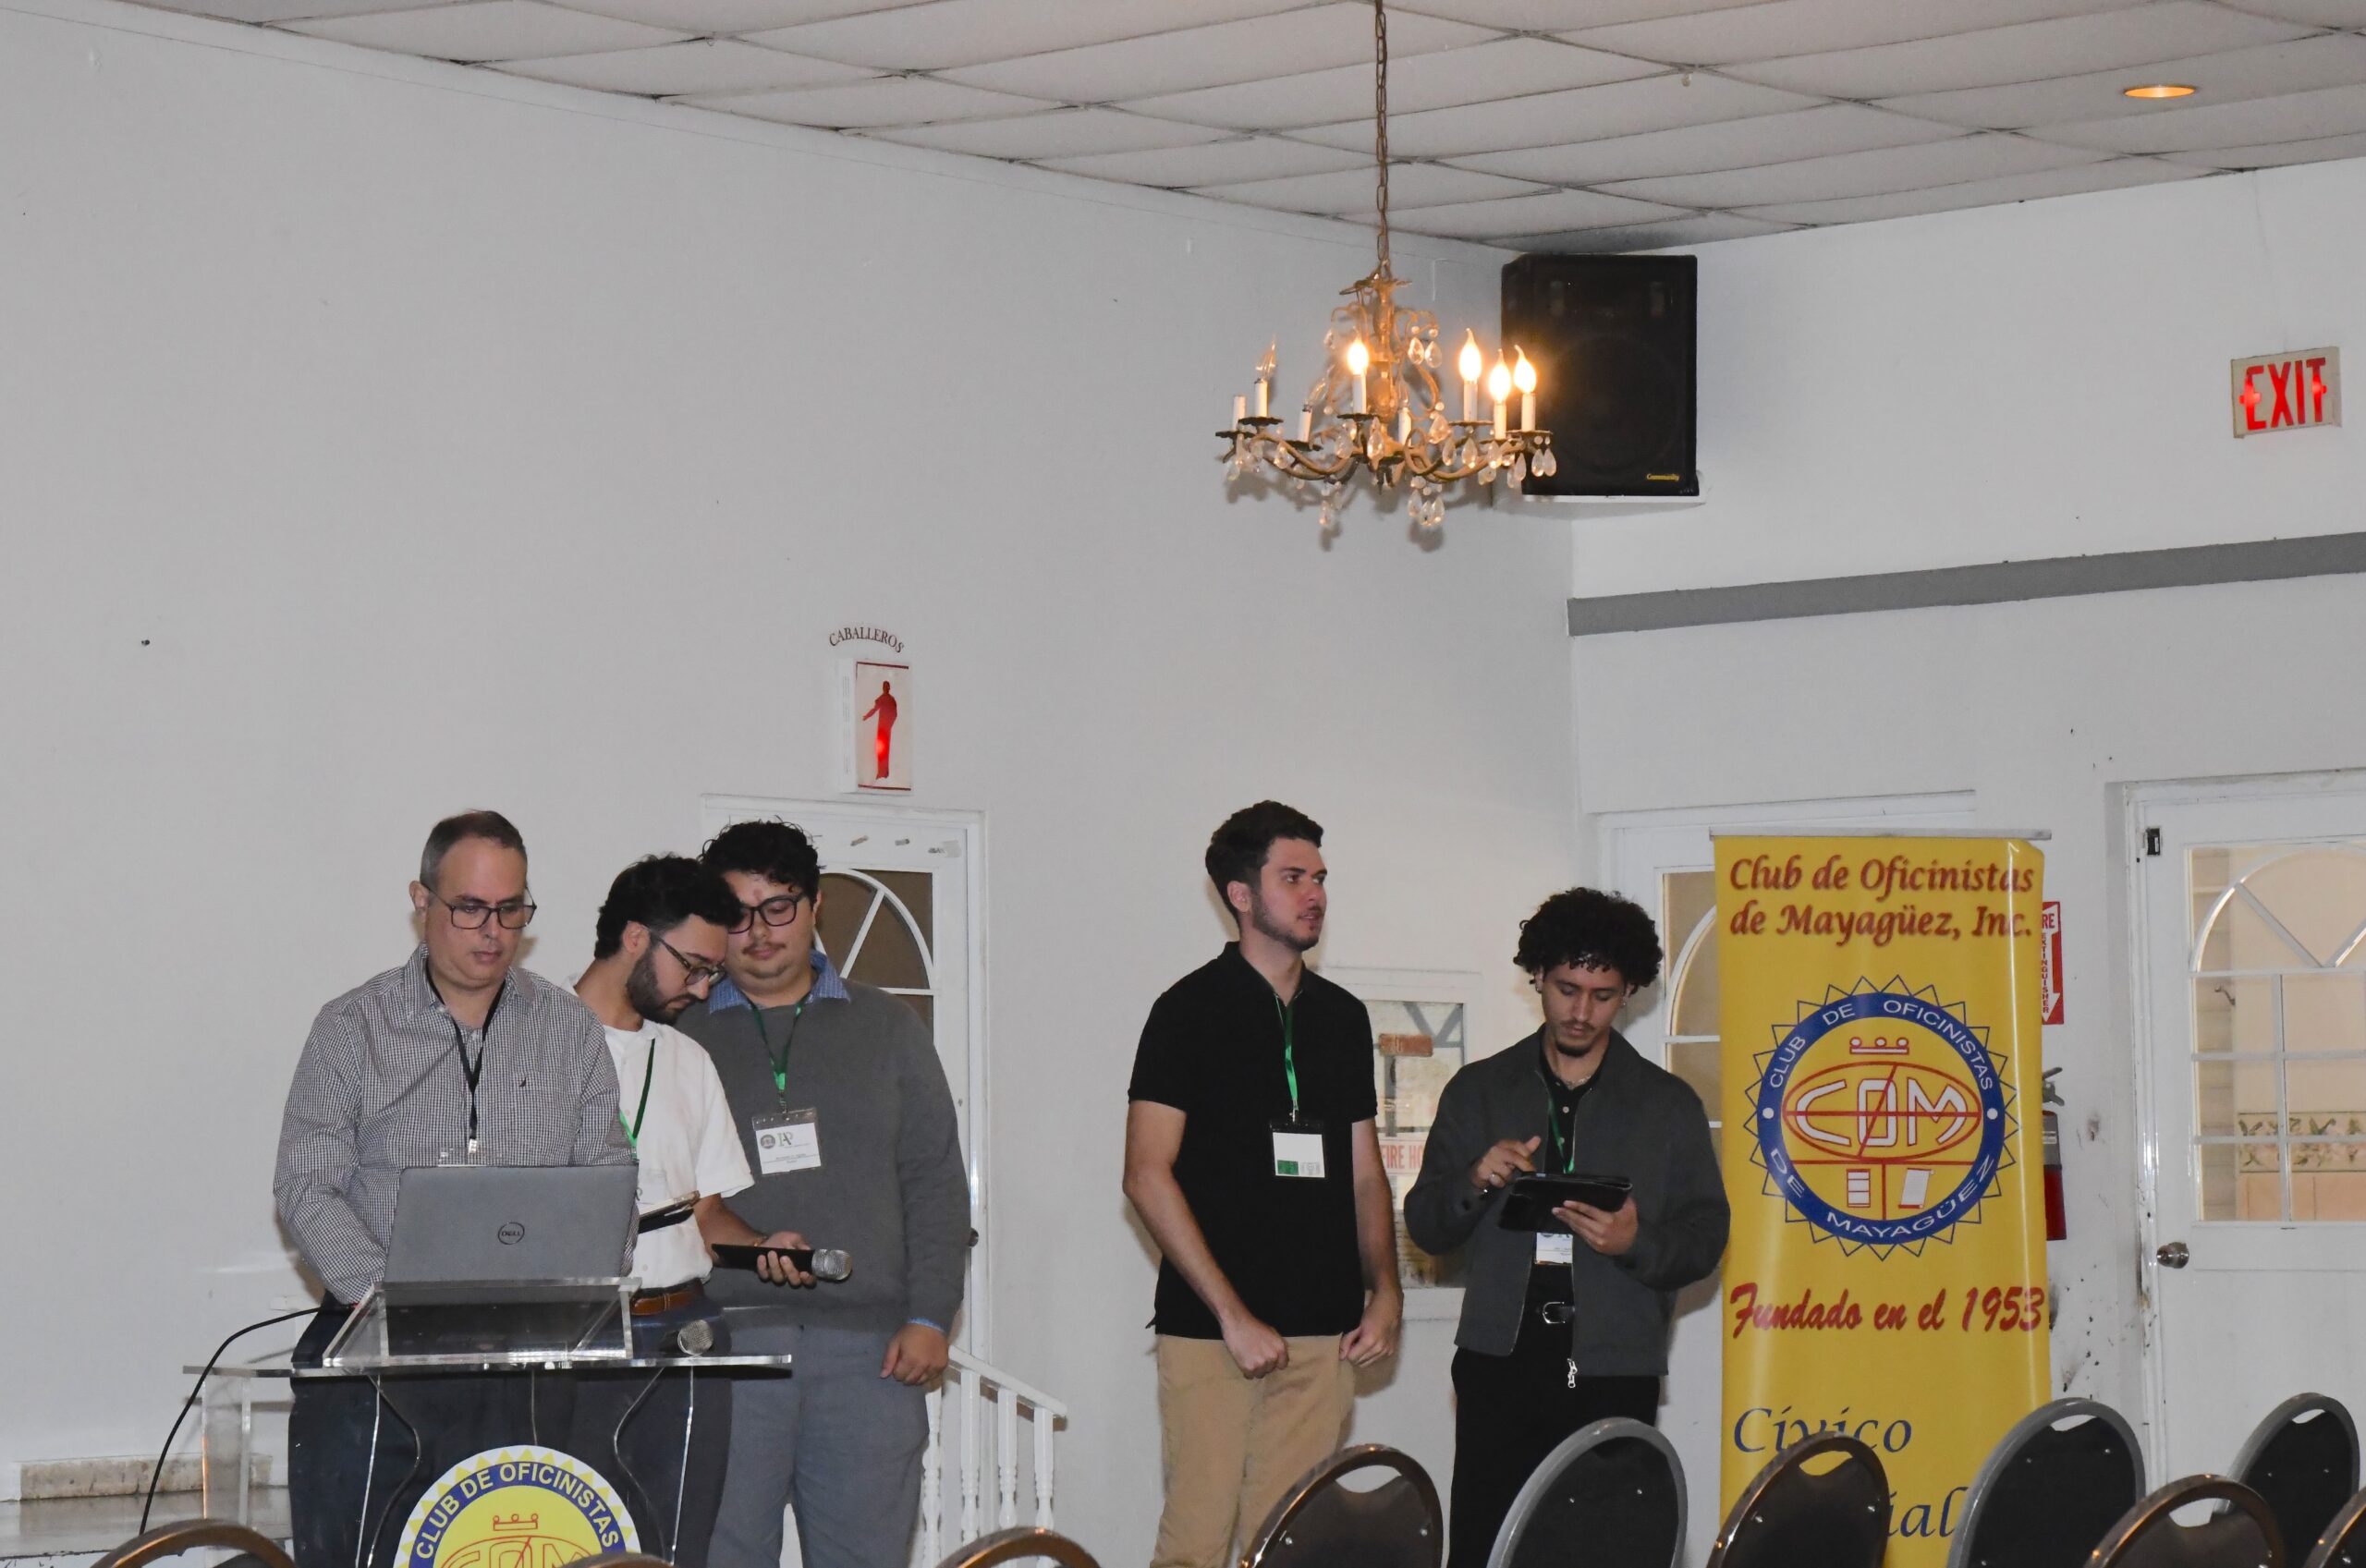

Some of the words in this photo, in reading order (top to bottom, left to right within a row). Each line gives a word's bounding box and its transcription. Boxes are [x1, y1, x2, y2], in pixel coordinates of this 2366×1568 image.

[2244, 357, 2326, 431] EXIT
[829, 626, 905, 653] CABALLEROS
[1730, 854, 1802, 891] Club
[1811, 854, 1849, 891] de
[1860, 855, 2034, 902] Oficinistas
[1730, 899, 1766, 936] de
[1776, 904, 1961, 947] Mayagüez,
[1971, 905, 2033, 937] Inc.
[2042, 913, 2055, 929] RE
[1770, 1036, 1806, 1088] CLUB
[1823, 1003, 1855, 1026] DE
[1884, 1000, 1993, 1090] OFICINISTAS
[1770, 1149, 1805, 1198] DE
[1826, 1155, 1994, 1237] MAYAGÜEZ
[1729, 1282, 1862, 1340] Fundado
[1873, 1302, 1908, 1331] en
[1918, 1288, 1946, 1331] el
[1961, 1286, 2045, 1333] 1953
[416, 1495, 460, 1559] CLUB
[459, 1469, 494, 1500] DE
[499, 1463, 619, 1548] OFICINISTAS
